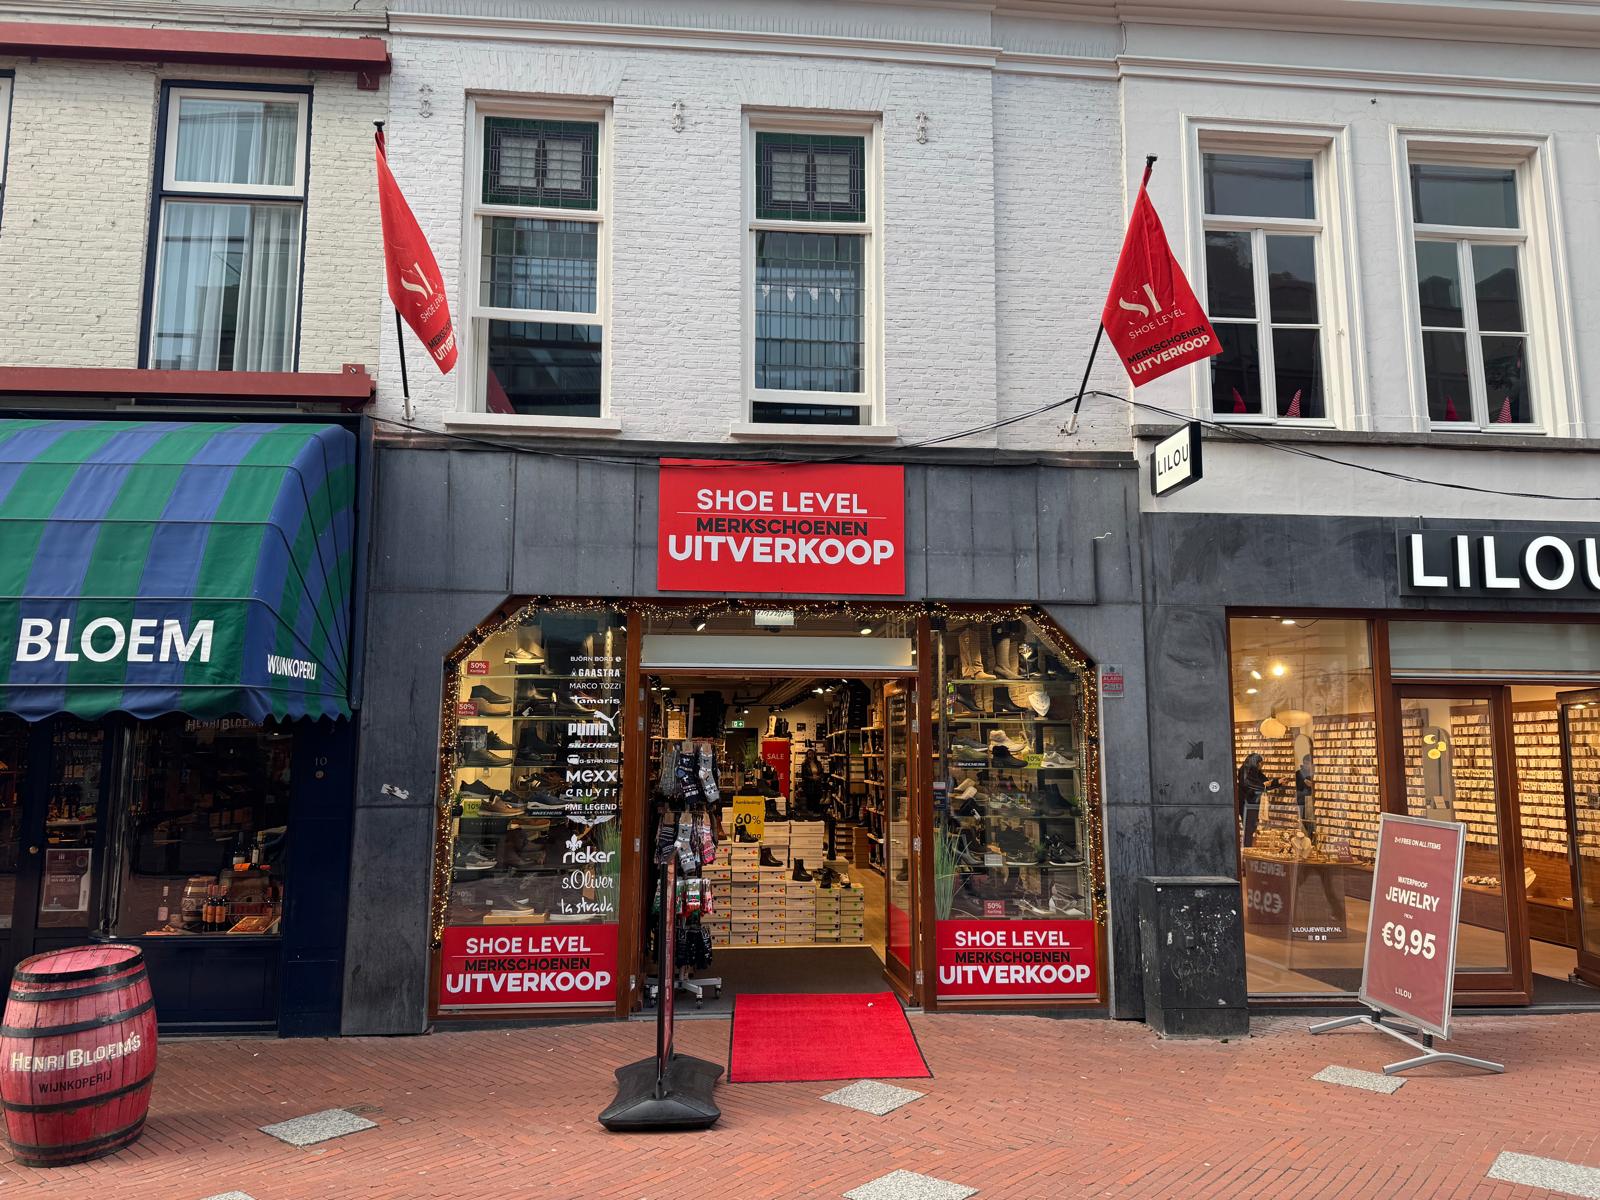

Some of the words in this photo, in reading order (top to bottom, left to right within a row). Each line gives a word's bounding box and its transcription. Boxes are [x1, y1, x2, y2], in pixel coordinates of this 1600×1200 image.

[1128, 321, 1156, 340] SHOE
[1157, 308, 1186, 327] LEVEL
[1127, 324, 1207, 365] MERKSCHOENEN
[1131, 334, 1211, 375] UITVERKOOP
[1157, 443, 1190, 477] LILOU
[696, 489, 774, 513] SHOE
[782, 491, 868, 515] LEVEL
[696, 517, 868, 537] MERKSCHOENEN
[668, 534, 895, 566] UITVERKOOP
[15, 616, 215, 662] BLOEM
[267, 654, 318, 681] WIJNKOPERIJ
[578, 668, 621, 678] GAASTRA
[569, 682, 598, 690] MARCO
[600, 682, 621, 690] TOZZI
[459, 703, 475, 711] 50%
[567, 722, 608, 736] PUMA
[565, 788, 618, 797] CRUYFF
[585, 803, 618, 811] LEGEND
[735, 813, 761, 824] 60%
[1412, 839, 1419, 847] ON
[1427, 842, 1441, 850] ITEMS
[562, 846, 616, 864] rieker
[561, 869, 614, 889] s.Oliver
[1397, 876, 1429, 889] WATERPROOF
[560, 898, 573, 914] la
[576, 896, 614, 914] strada
[1385, 886, 1440, 913] JEWELRY
[955, 931, 1007, 947] SHOE
[1012, 931, 1071, 947] LEVEL
[1291, 926, 1343, 934] LILOUJEWELRY.NL
[466, 937, 523, 954] SHOE
[528, 936, 592, 953] LEVEL
[1381, 921, 1437, 960] €9,95
[465, 958, 591, 972] MERKSCHOENEN
[955, 951, 1071, 964] MERKSCHOENEN
[446, 971, 611, 993] UITVERKOOP
[939, 964, 1091, 985] UITVERKOOP
[1394, 987, 1412, 1000] LILOU
[10, 1051, 65, 1073] HENRI
[38, 1071, 112, 1094] WIJNKOPERIJ
